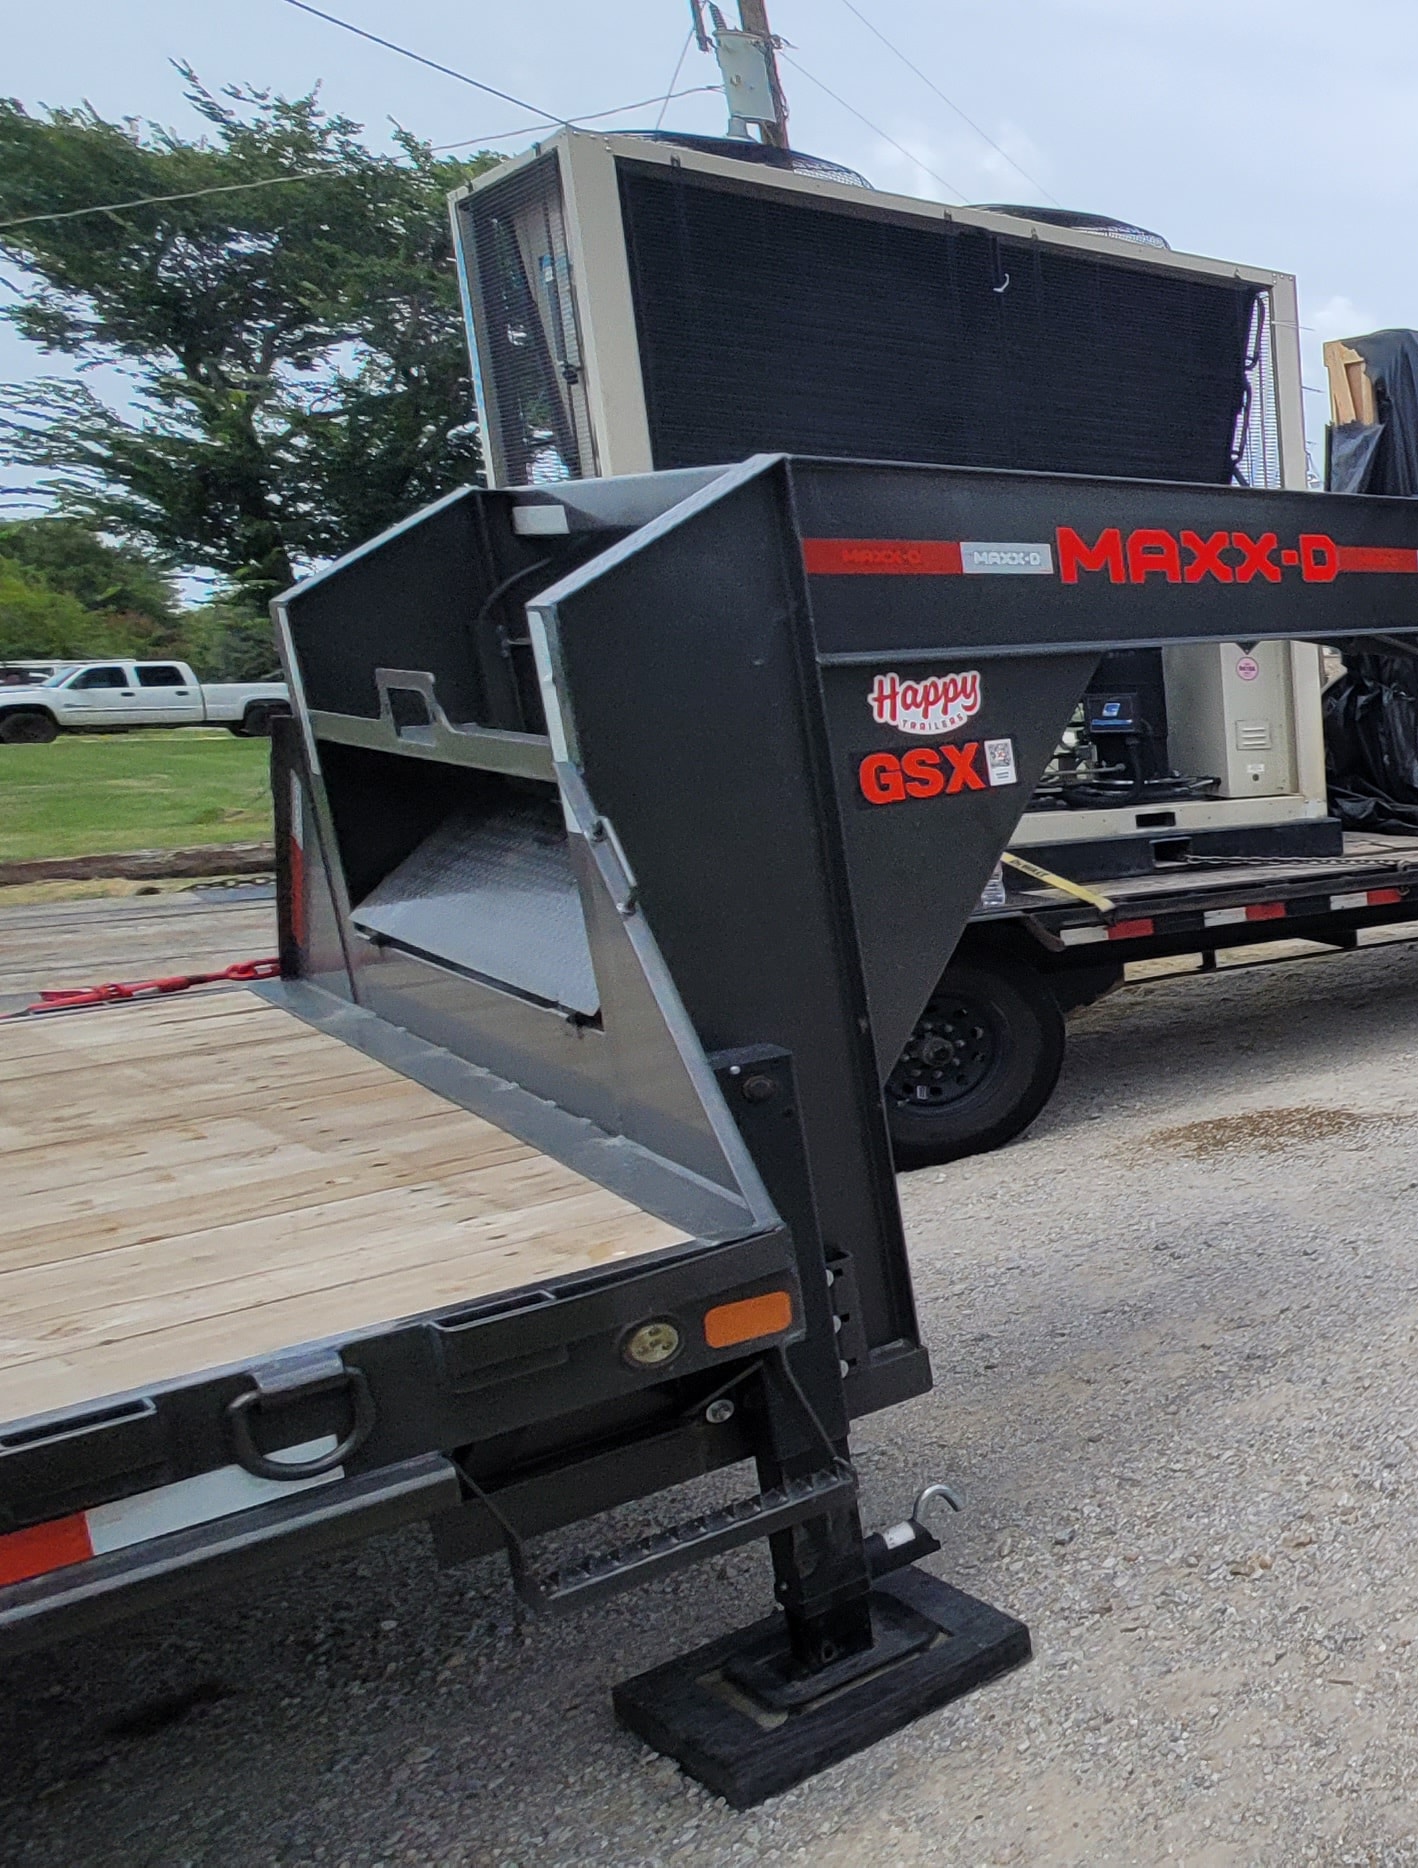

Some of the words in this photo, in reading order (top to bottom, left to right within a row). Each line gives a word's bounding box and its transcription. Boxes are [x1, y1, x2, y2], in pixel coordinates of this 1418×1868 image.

[973, 550, 1041, 566] MAXX-D
[1056, 526, 1337, 583] MAXX-D
[872, 674, 978, 722] Happy
[902, 713, 964, 731] TRAILERS
[859, 742, 986, 805] GSX
